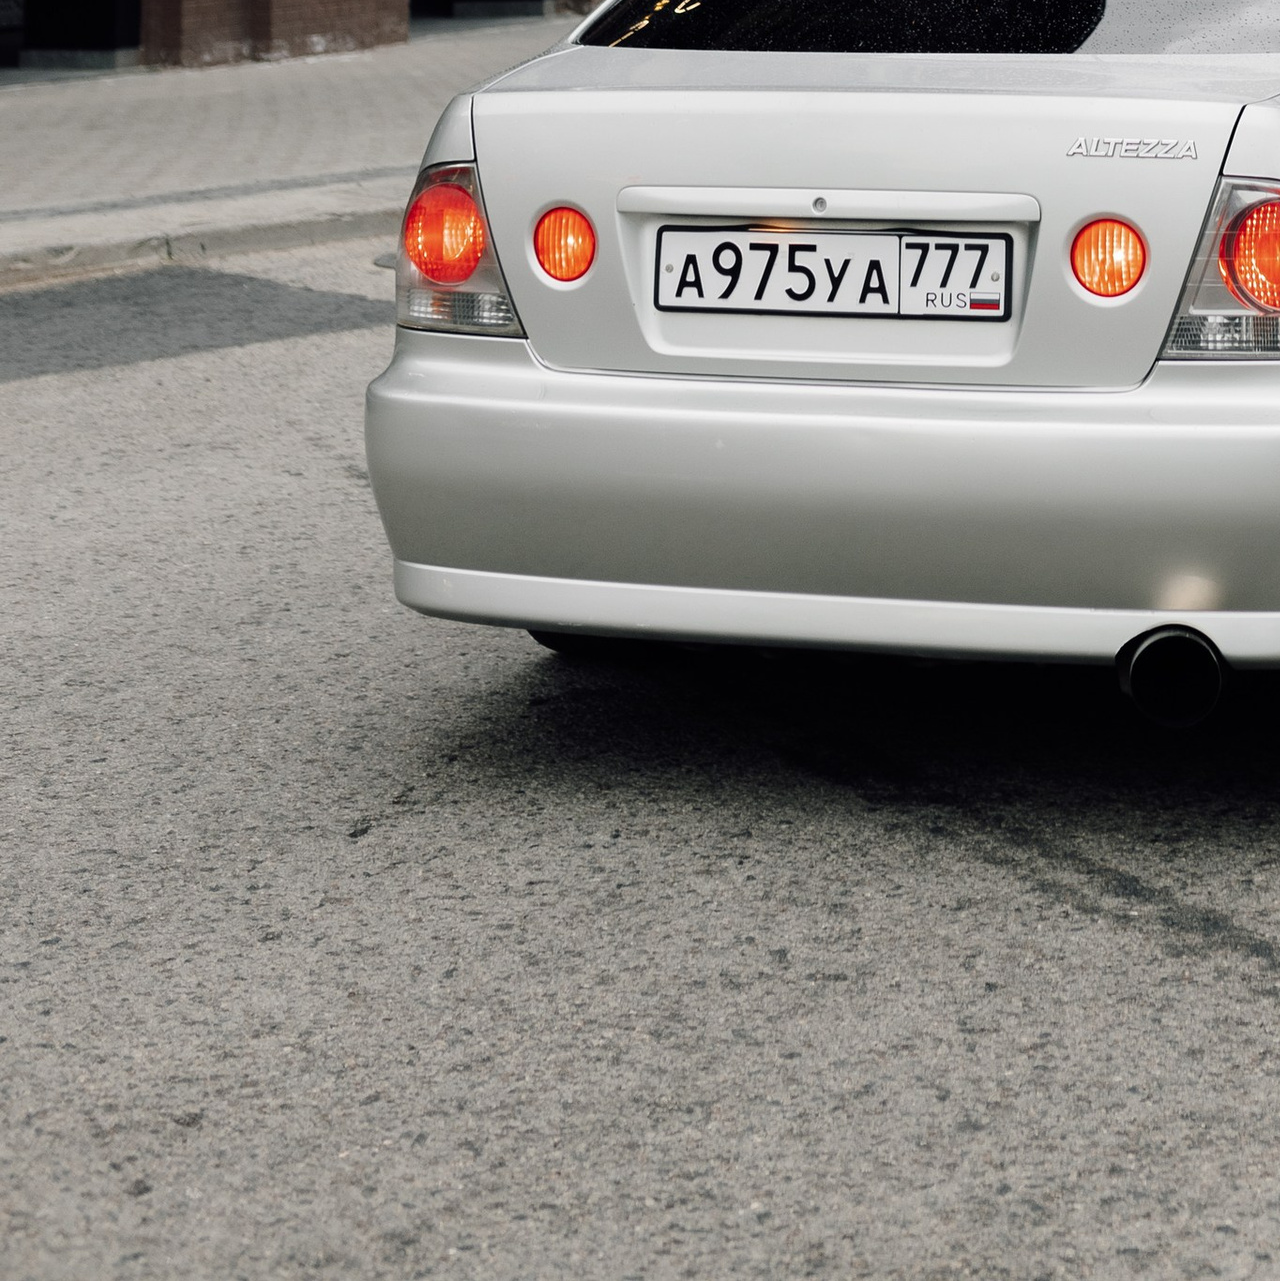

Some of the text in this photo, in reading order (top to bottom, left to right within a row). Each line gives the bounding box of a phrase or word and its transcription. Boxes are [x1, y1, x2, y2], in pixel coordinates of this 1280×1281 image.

[1066, 137, 1198, 159] ALTEZZA
[905, 242, 990, 288] 777
[925, 292, 967, 308] RUS
